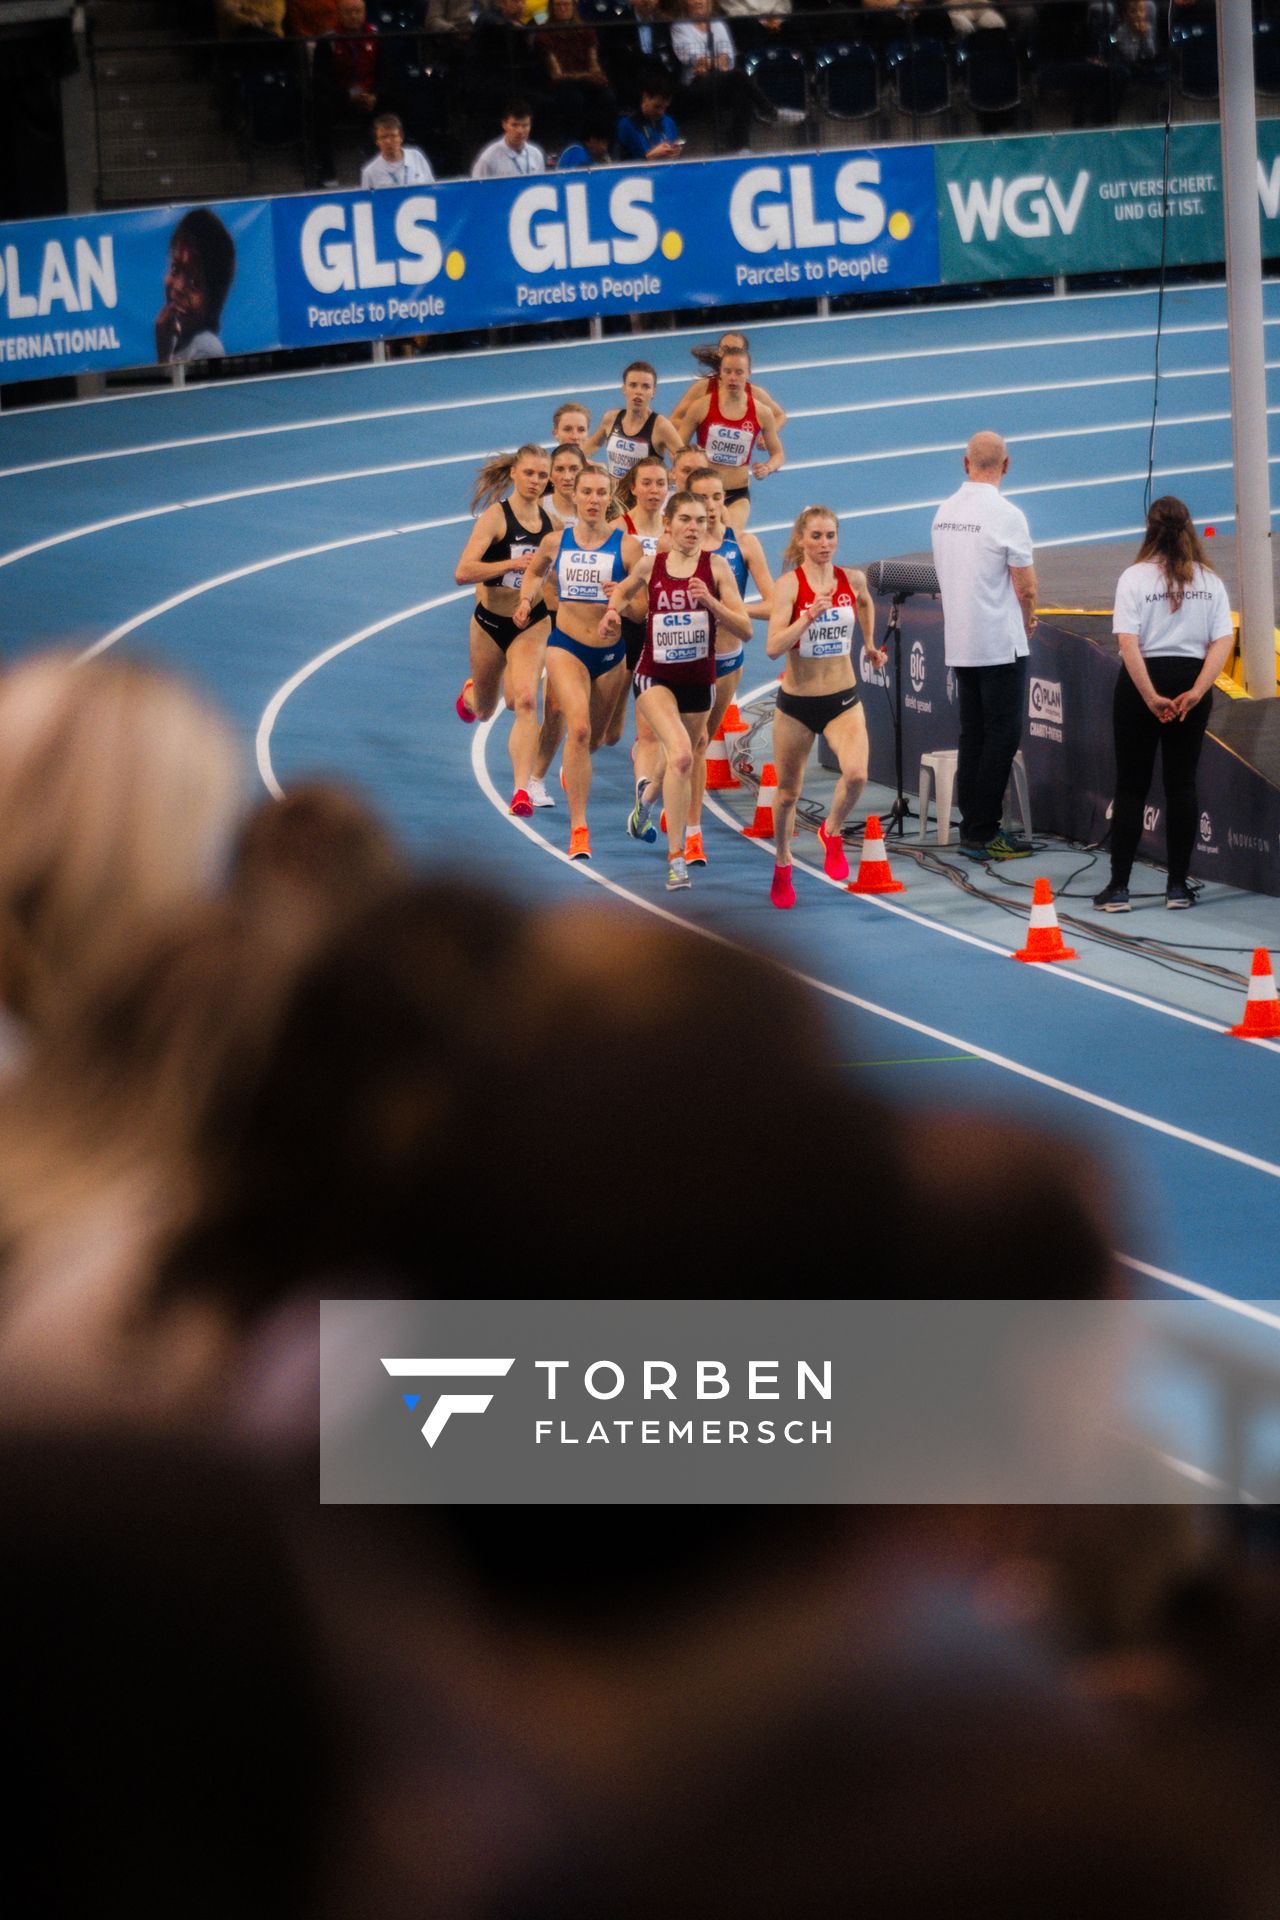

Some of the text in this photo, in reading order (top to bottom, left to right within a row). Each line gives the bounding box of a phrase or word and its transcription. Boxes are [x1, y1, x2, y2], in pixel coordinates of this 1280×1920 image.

[1098, 181, 1127, 200] GUT
[947, 168, 1088, 243] WGV
[1114, 203, 1145, 221] UND
[1179, 198, 1205, 216] IST.
[735, 253, 889, 287] Parcels to People
[516, 273, 661, 307] Parcels to People
[307, 294, 445, 328] Parcels to People
[718, 428, 741, 440] GLS
[615, 440, 636, 452] GLS
[711, 440, 745, 454] SCHEID
[571, 553, 597, 565] GLS
[663, 614, 691, 627] GLS
[657, 629, 706, 647] COUTELLIER
[808, 625, 848, 642] WREDE
